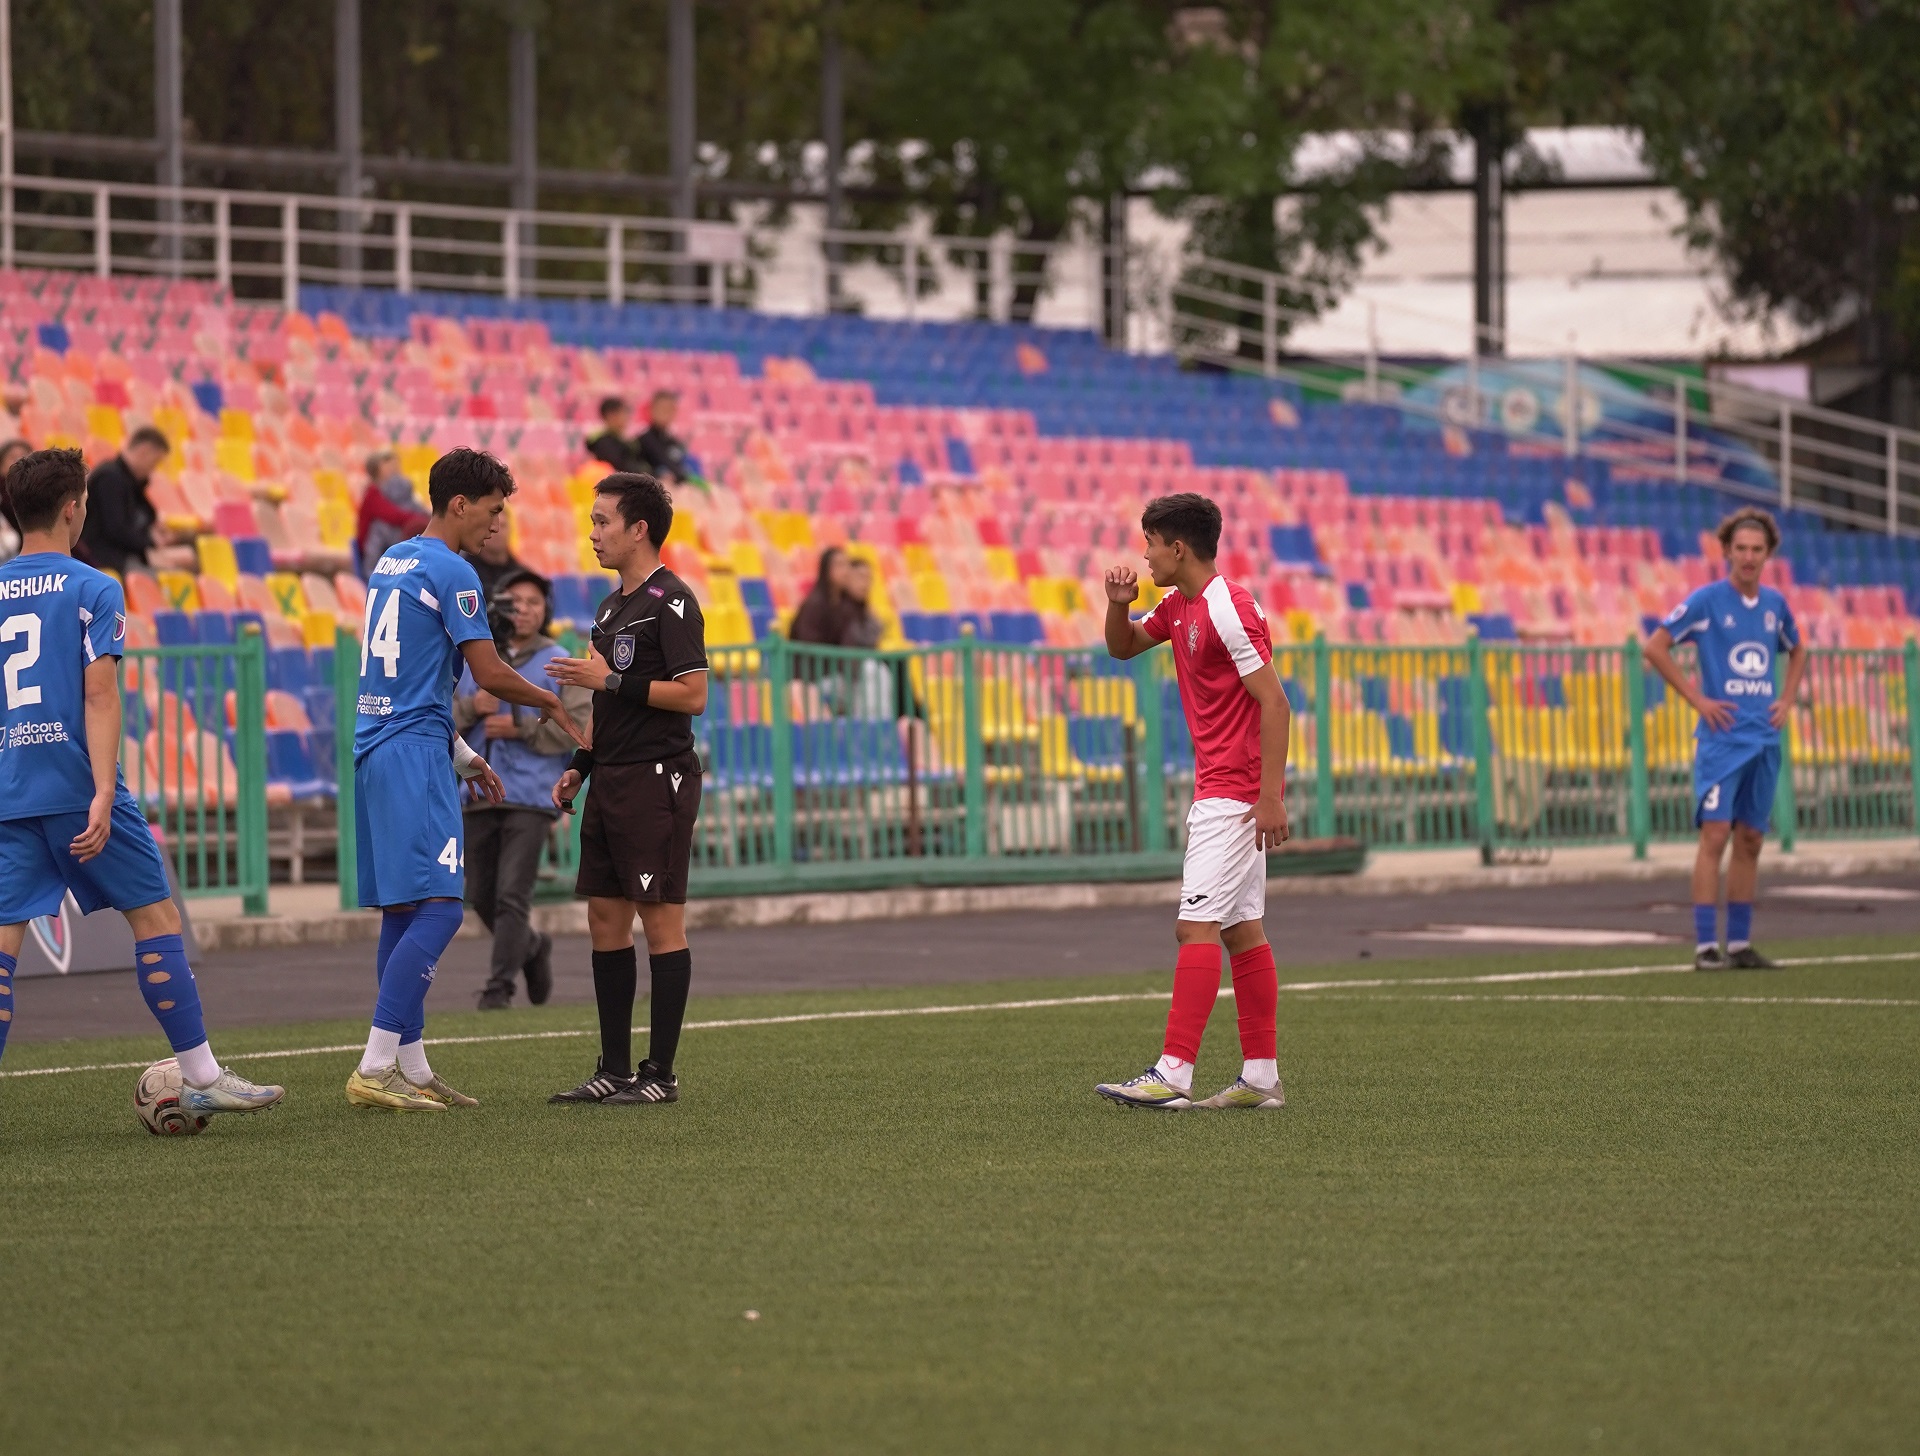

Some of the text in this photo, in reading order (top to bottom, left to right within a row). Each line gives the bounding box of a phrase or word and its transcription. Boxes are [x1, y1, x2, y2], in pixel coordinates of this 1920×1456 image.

[0, 574, 68, 600] NSHUAK
[0, 612, 42, 711] 2
[9, 721, 63, 738] solidcore
[8, 732, 69, 749] resources
